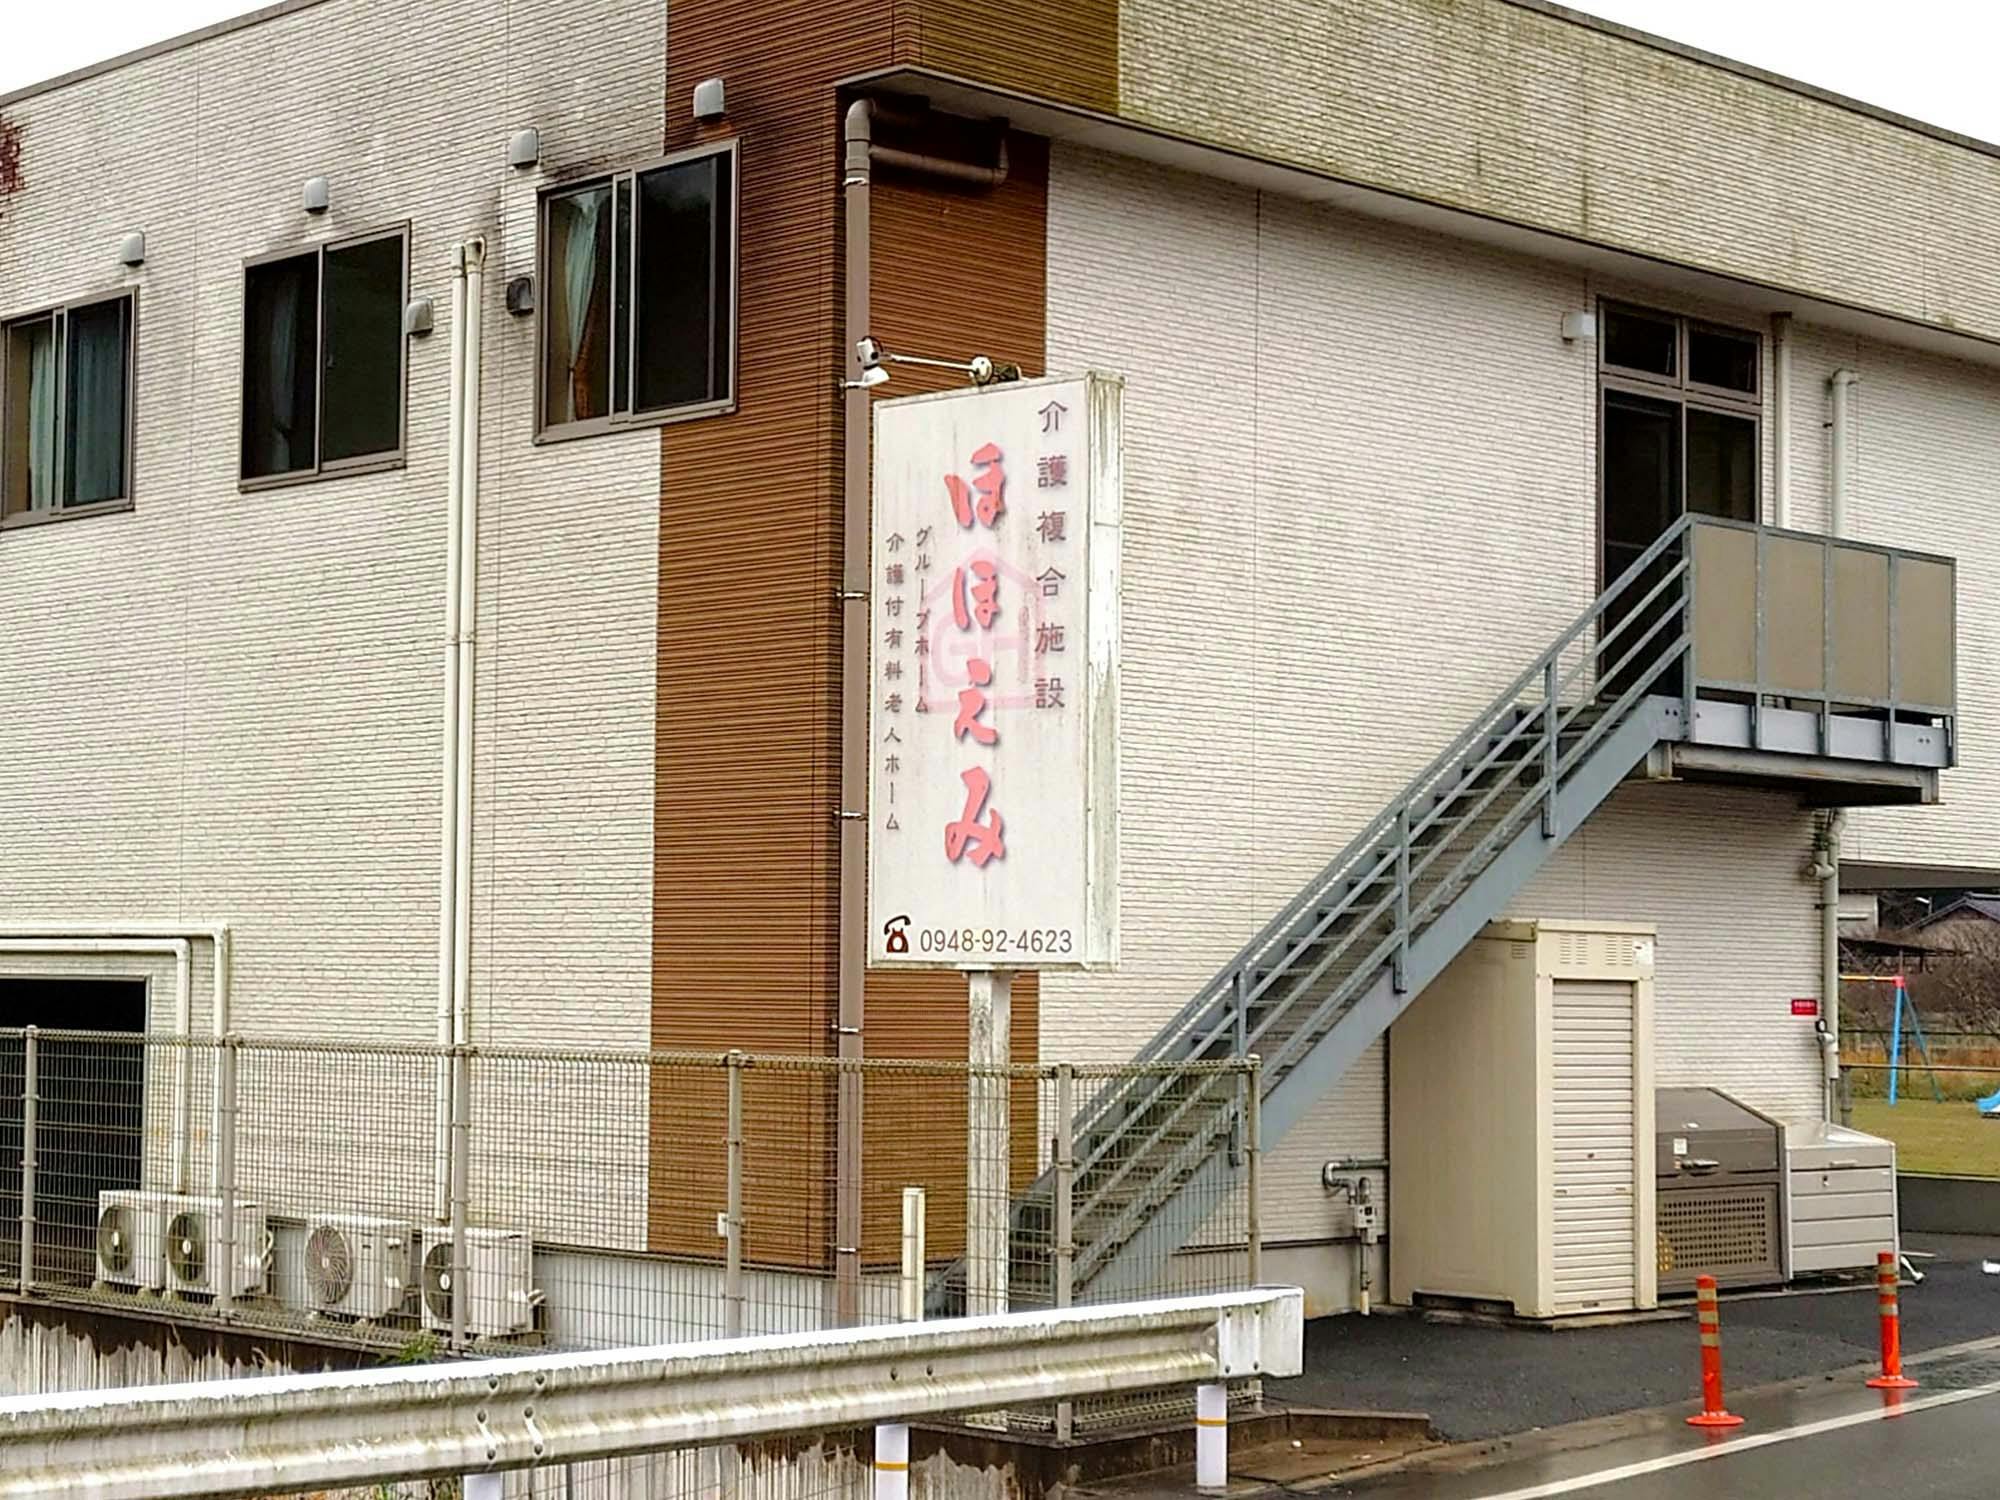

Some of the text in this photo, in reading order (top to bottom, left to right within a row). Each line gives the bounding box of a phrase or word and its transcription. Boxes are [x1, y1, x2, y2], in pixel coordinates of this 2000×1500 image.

[883, 532, 905, 831] 介護付有料老人ホーム
[914, 526, 933, 714] グループホーム
[943, 442, 1006, 869] ほほえみ
[1034, 400, 1068, 709] 介護複合施設
[920, 929, 1073, 953] 0948-92-4623
